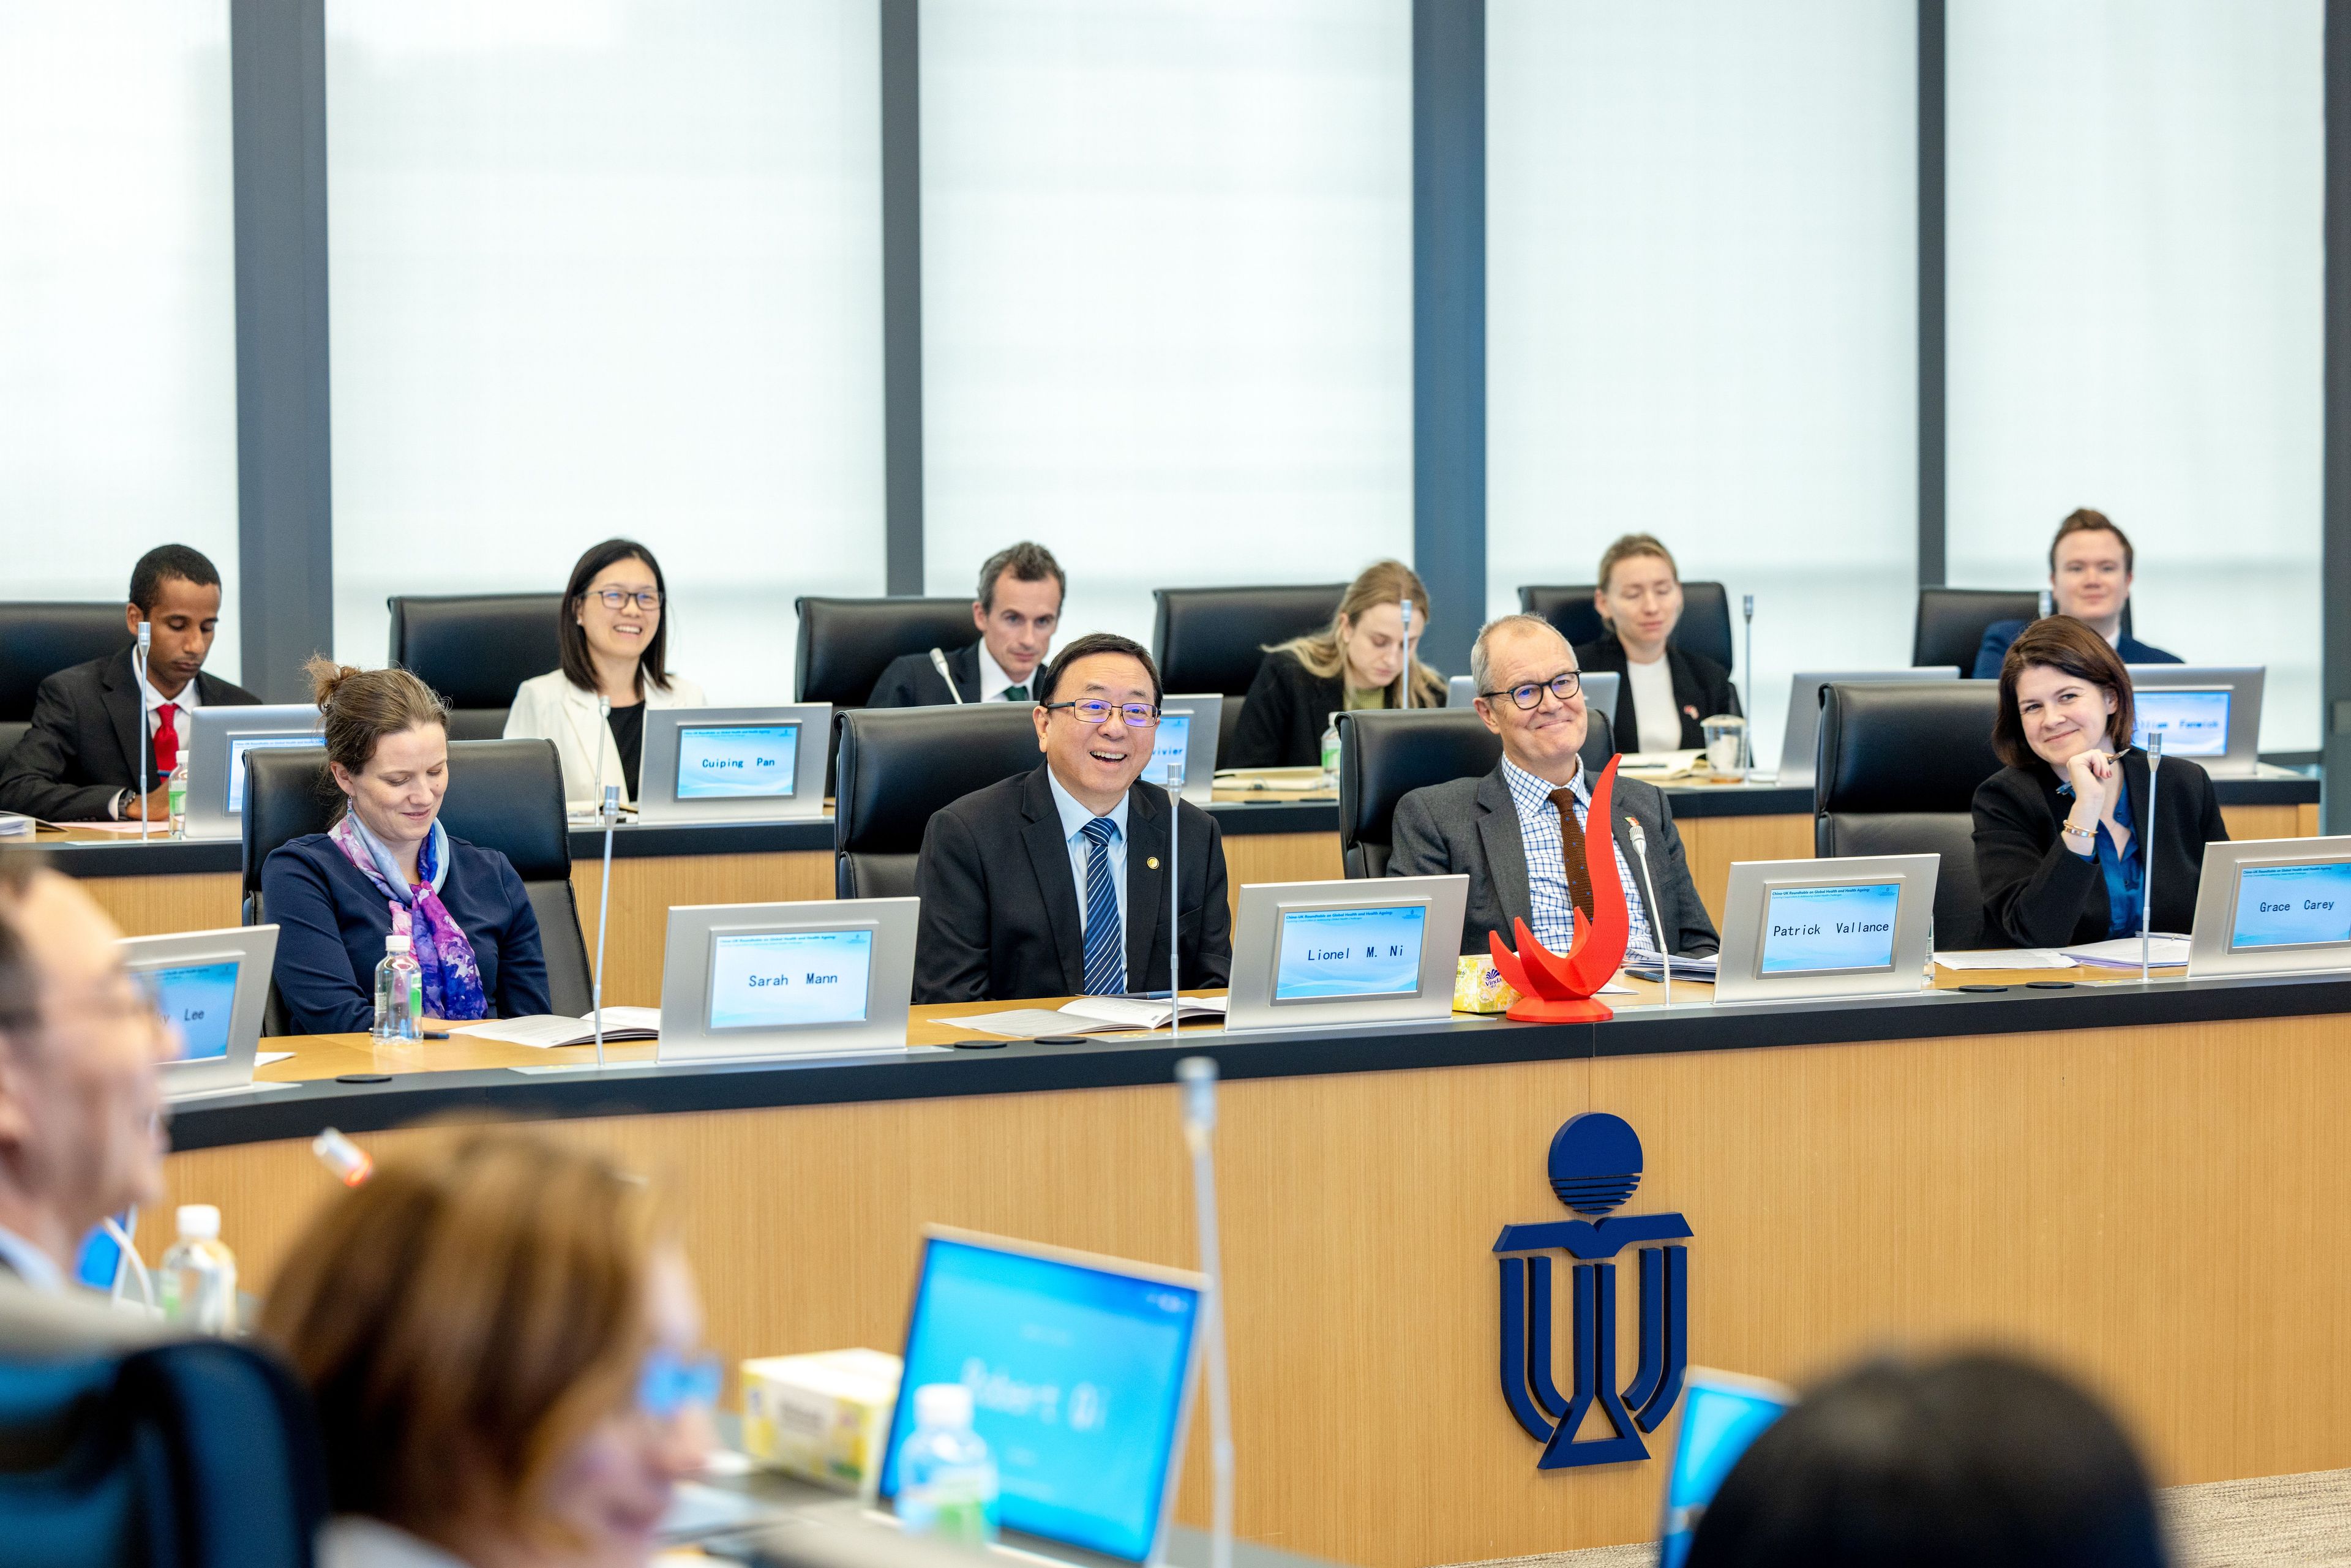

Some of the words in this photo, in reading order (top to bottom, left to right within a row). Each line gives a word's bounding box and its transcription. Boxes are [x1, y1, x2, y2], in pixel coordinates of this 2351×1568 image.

[702, 758, 743, 769] Cuiping
[757, 757, 775, 767] Pan
[2260, 902, 2290, 912] Grace
[2304, 899, 2334, 910] Carey
[1773, 924, 1821, 937] Patrick
[1836, 922, 1889, 934] Vallance
[1308, 948, 1349, 961] Lionel
[1366, 947, 1378, 958] M.
[1390, 945, 1403, 956] Ni
[749, 974, 789, 987] Sarah
[806, 972, 838, 985] Mann
[1485, 978, 1502, 986] Vinda
[184, 1008, 204, 1021] Lee
